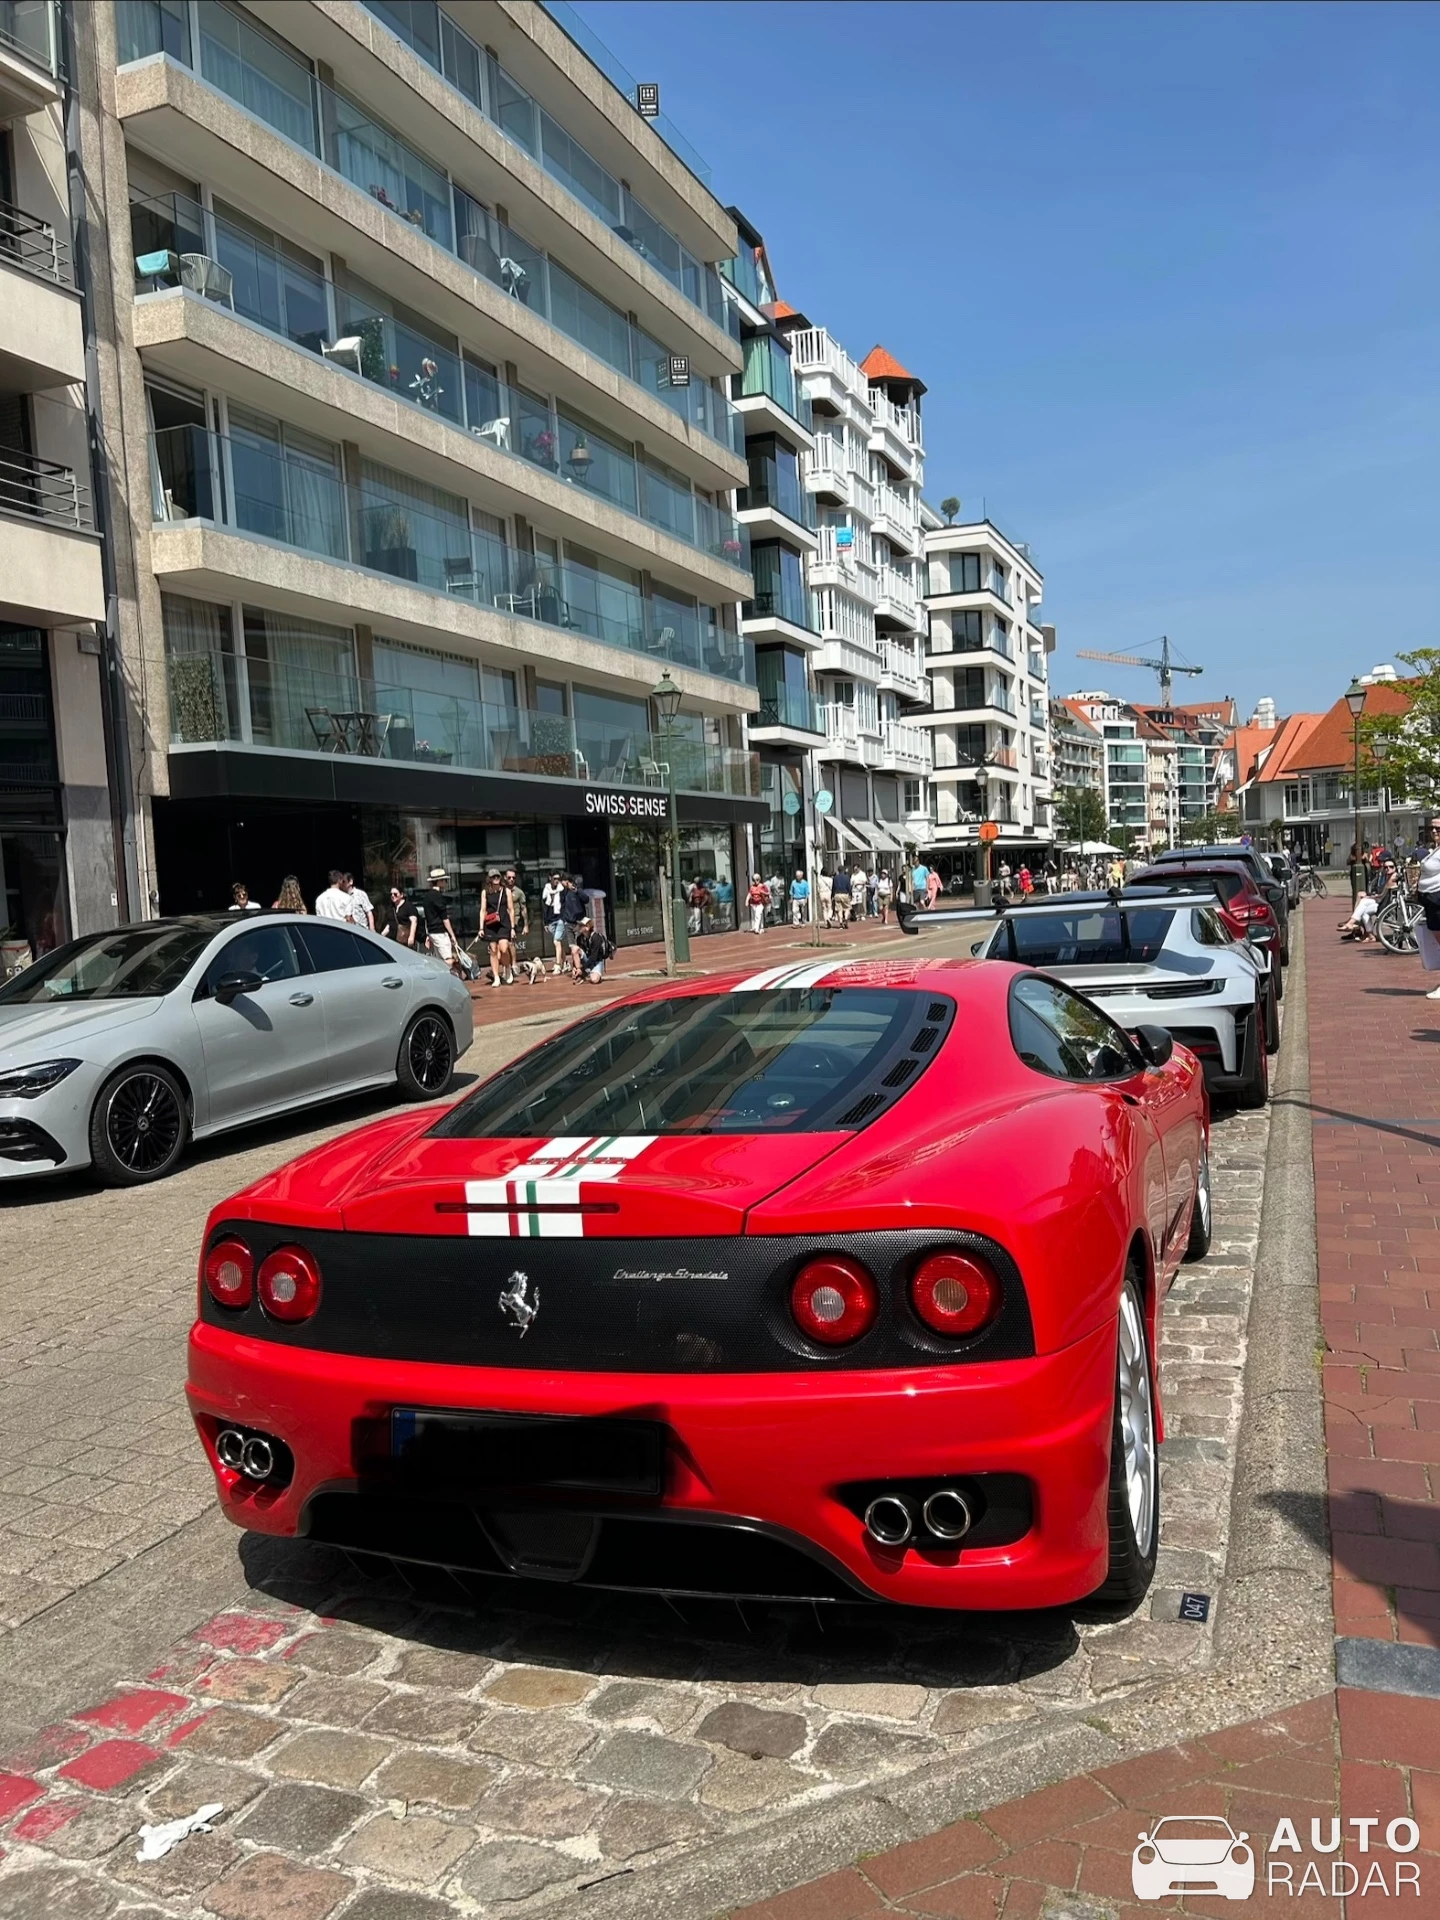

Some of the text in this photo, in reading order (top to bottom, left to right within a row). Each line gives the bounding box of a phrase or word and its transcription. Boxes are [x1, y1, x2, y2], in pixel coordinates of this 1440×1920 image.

[585, 792, 667, 817] SWISS SENSE
[1184, 1596, 1205, 1618] 047
